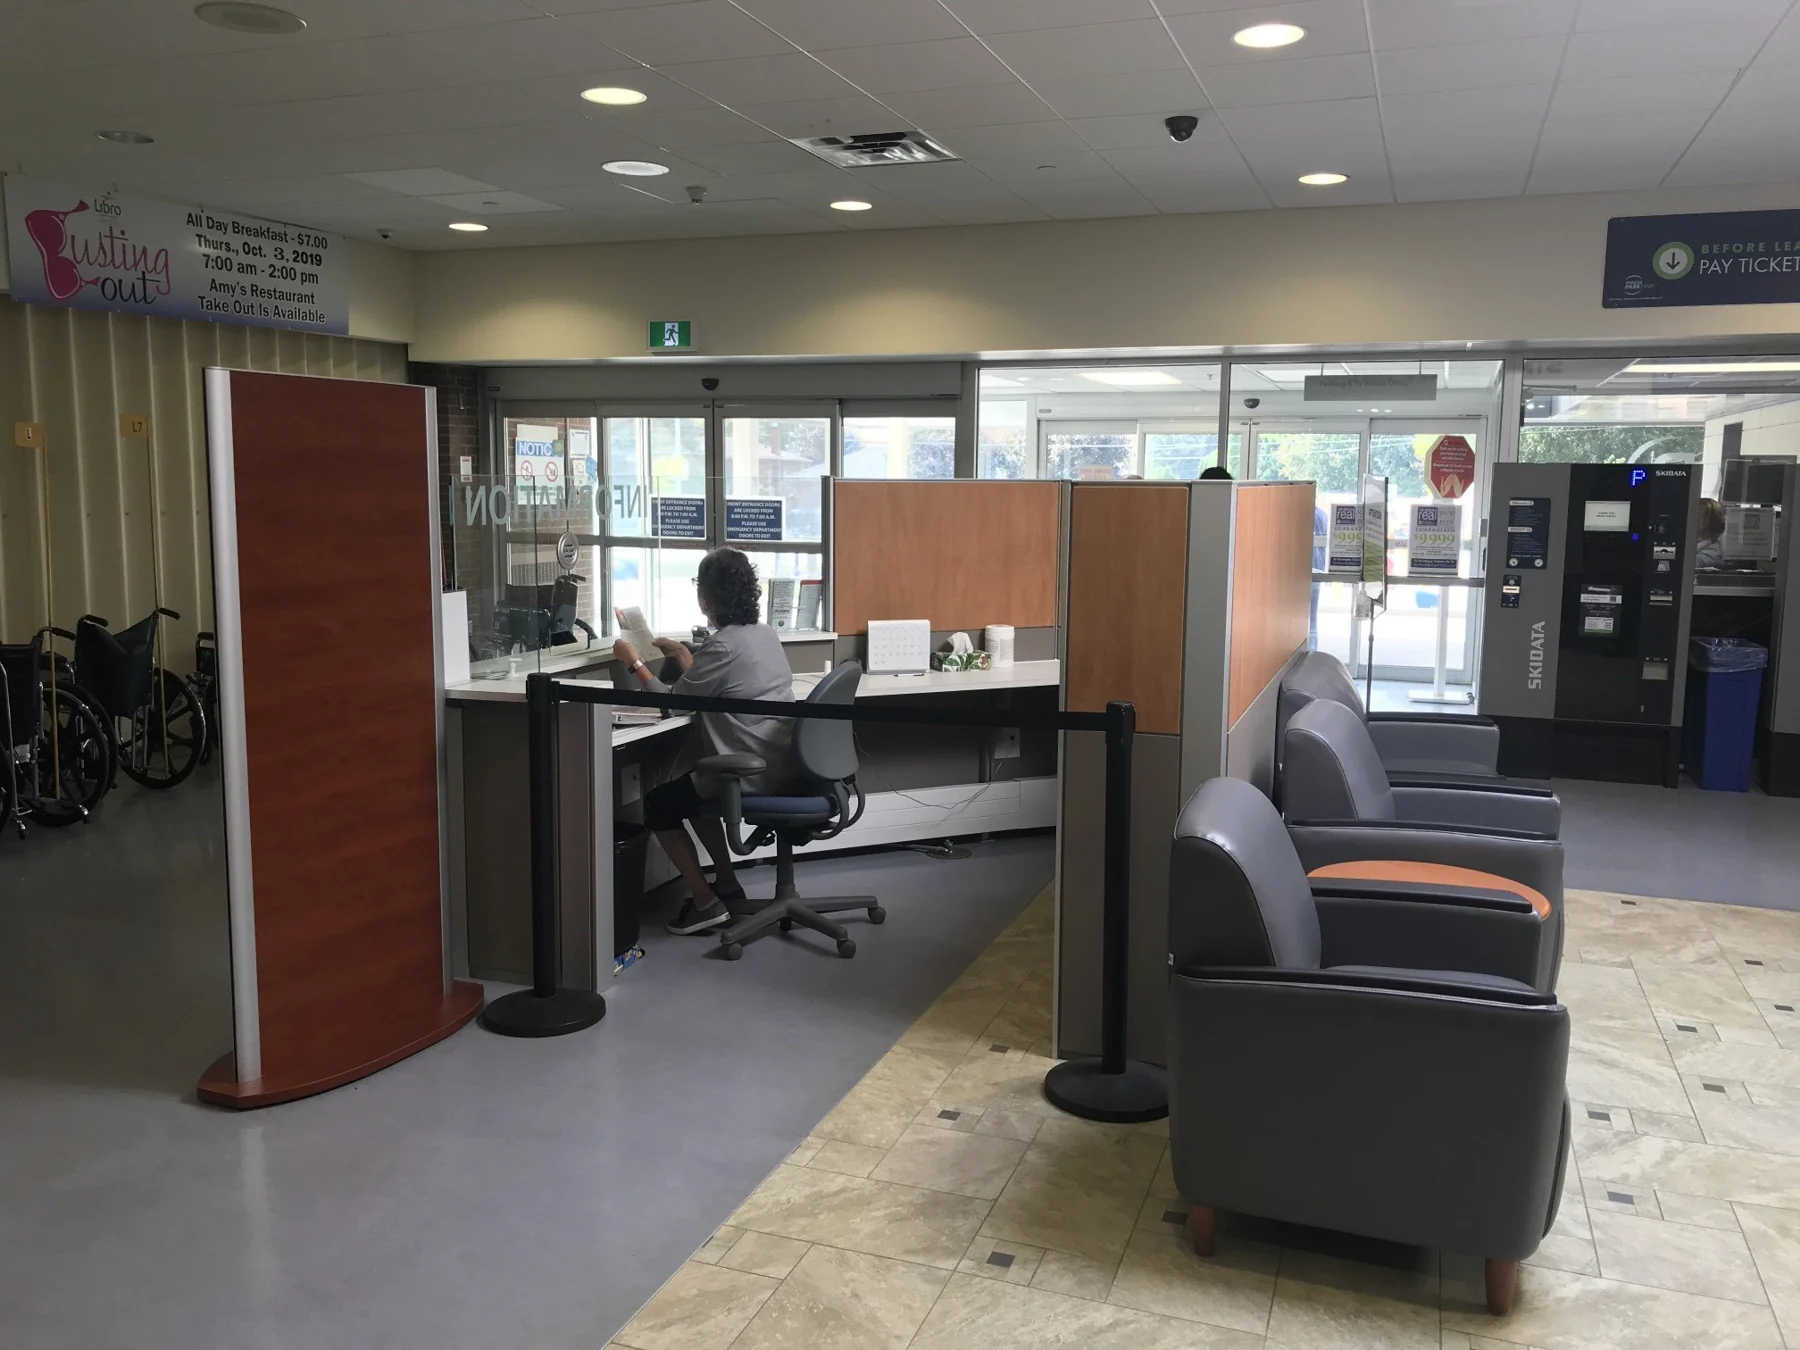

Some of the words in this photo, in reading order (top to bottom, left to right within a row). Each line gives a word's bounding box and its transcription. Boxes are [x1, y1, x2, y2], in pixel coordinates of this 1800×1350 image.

[94, 198, 121, 216] Libro
[186, 212, 202, 228] All
[206, 215, 228, 235] Day
[232, 220, 288, 244] Breakfast
[297, 232, 328, 250] $7.00
[195, 233, 239, 256] Thurs.,
[242, 241, 267, 258] Oct.
[274, 246, 290, 263] 3,
[292, 250, 322, 267] 2019
[1701, 242, 1766, 254] BEFORE
[202, 253, 233, 272] 7:00
[236, 261, 257, 276] am
[268, 263, 297, 281] 2:00
[300, 271, 318, 286] pm
[1699, 258, 1734, 274] PAY
[1738, 256, 1800, 273] TICKET
[100, 270, 161, 305] out
[209, 278, 247, 298] Amy's
[250, 283, 316, 304] Restaurant
[198, 296, 230, 313] Take
[233, 300, 256, 316] Out
[260, 303, 270, 318] Is
[272, 304, 326, 324] Available
[132, 421, 143, 433] L7
[519, 442, 553, 456] NOTIC
[1632, 470, 1646, 486] P
[1338, 510, 1355, 520] real
[1419, 511, 1437, 520] real
[1528, 621, 1546, 690] SKIDATA
